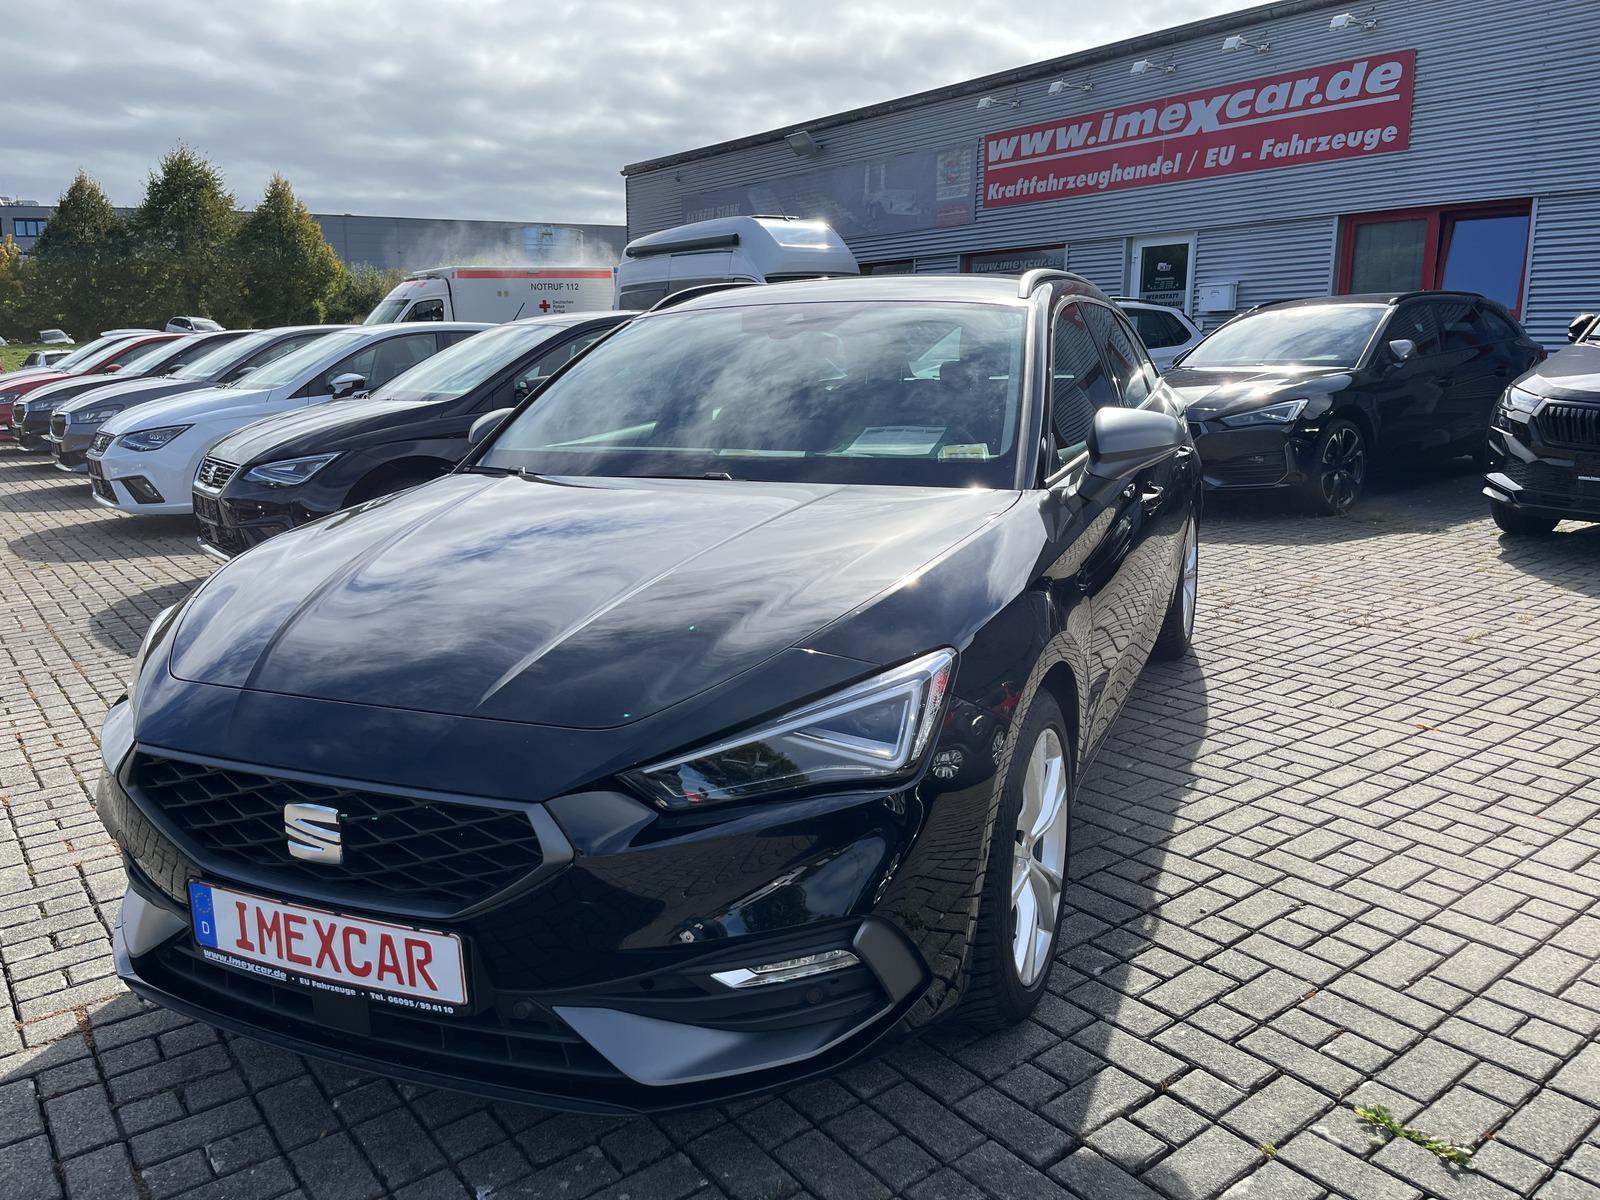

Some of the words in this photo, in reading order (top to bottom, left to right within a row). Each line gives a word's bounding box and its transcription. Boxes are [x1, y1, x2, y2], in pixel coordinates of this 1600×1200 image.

[987, 152, 1182, 200] Kraftfahrzeughandel
[1204, 145, 1236, 168] EU
[1259, 125, 1398, 160] Fahrzeuge
[531, 283, 563, 291] NOTRUF
[566, 283, 579, 291] 112
[202, 921, 209, 935] D
[235, 901, 438, 991] IMEXCAR
[300, 977, 310, 986] EU
[312, 980, 356, 996] Fahrzeuge
[370, 992, 386, 1002] Tel.
